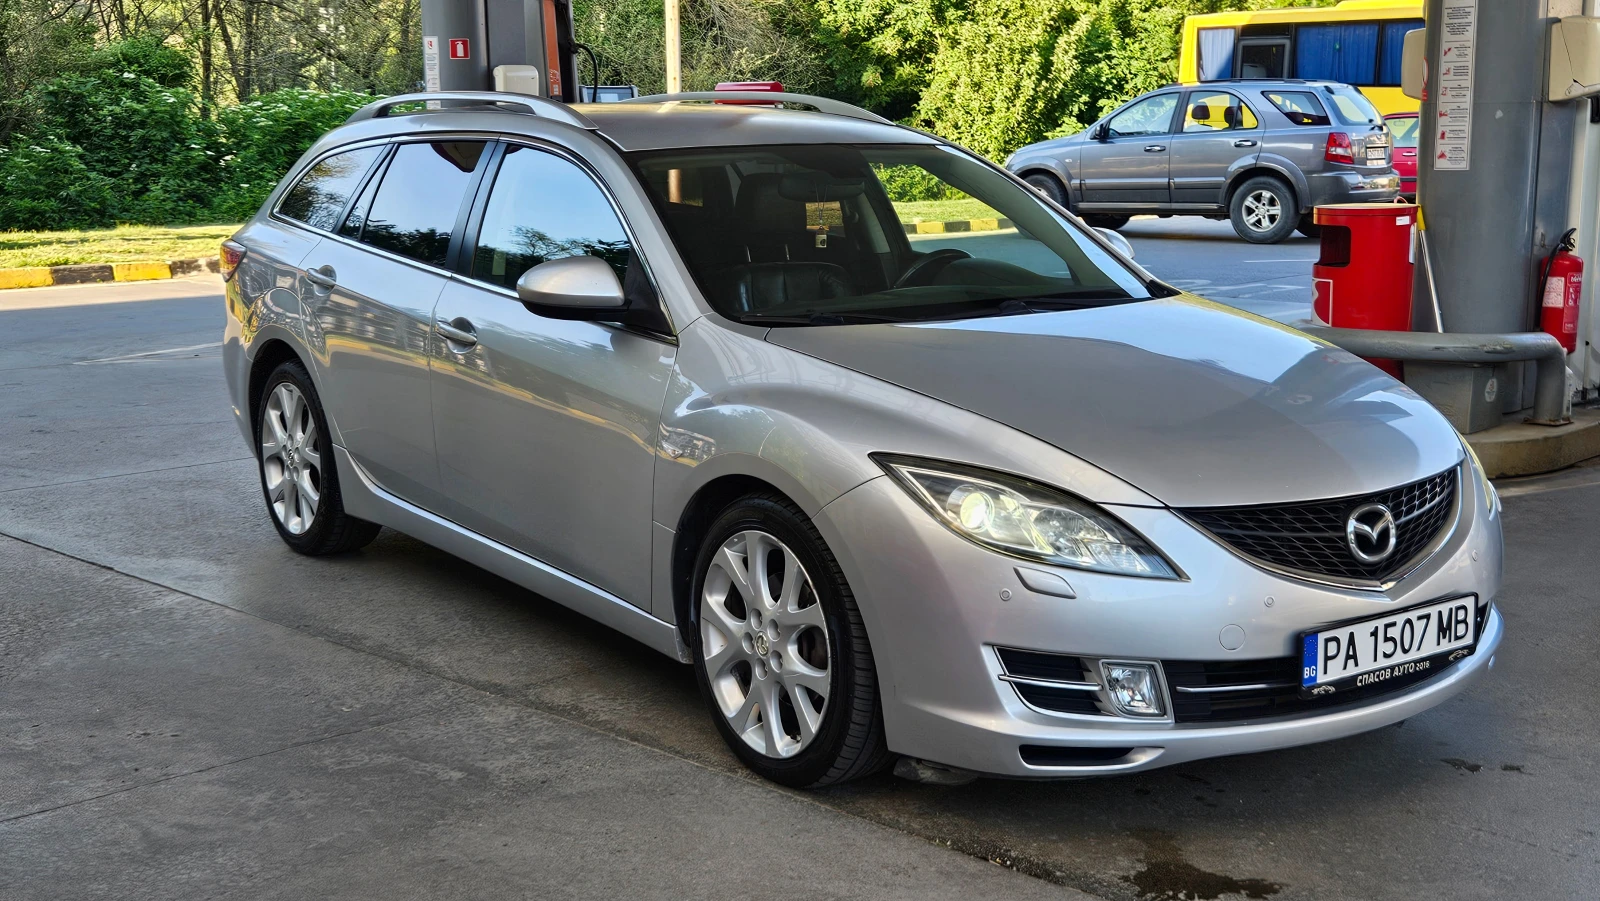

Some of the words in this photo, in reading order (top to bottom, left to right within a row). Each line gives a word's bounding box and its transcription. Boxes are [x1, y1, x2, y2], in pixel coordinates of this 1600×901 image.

[1323, 631, 1359, 675] PA
[1369, 613, 1432, 662] 1507
[1436, 604, 1469, 646] MB
[1304, 665, 1316, 679] BG
[1356, 668, 1391, 687] СПАСОВ
[1392, 662, 1415, 677] АУТО
